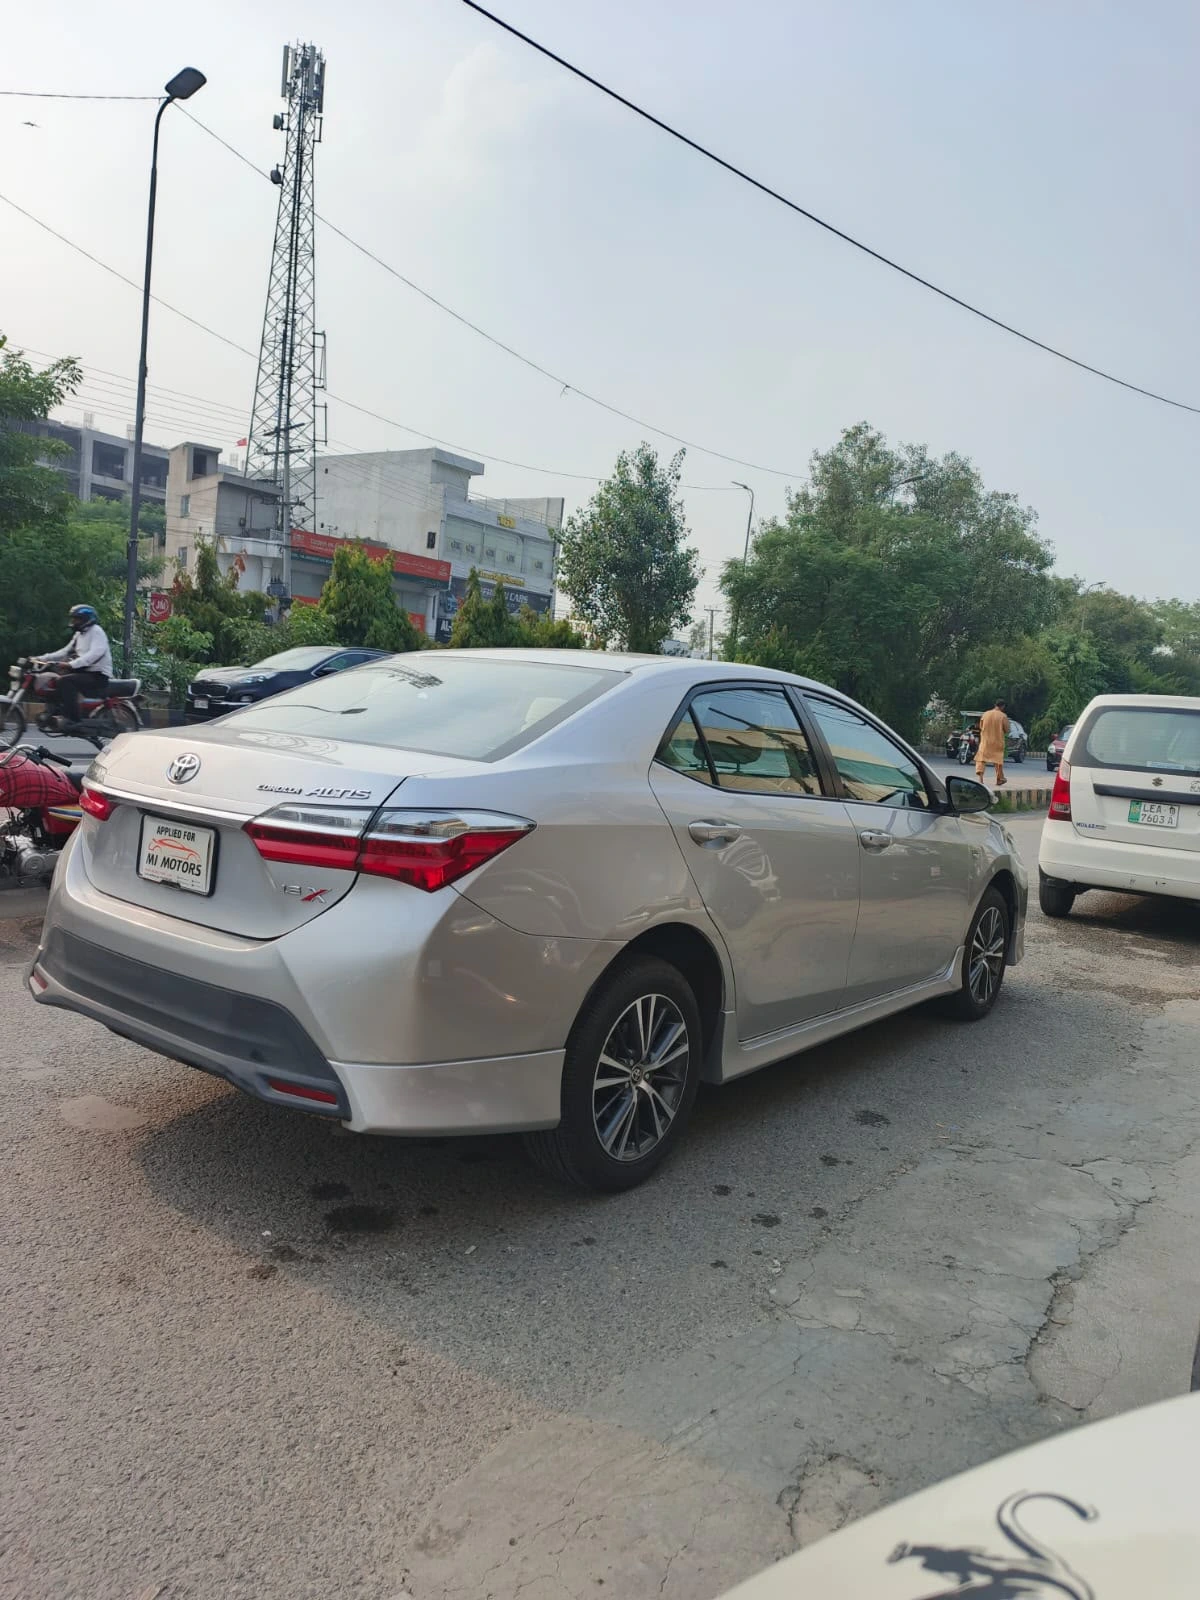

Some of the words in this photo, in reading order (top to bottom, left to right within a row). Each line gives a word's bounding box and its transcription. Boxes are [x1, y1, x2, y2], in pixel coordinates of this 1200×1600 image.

[305, 787, 371, 800] ALTIS
[1144, 803, 1162, 813] LEA
[1142, 813, 1164, 824] 7603
[156, 825, 182, 838] APPLIED
[182, 830, 196, 841] FOR
[146, 853, 158, 865] MI
[160, 856, 202, 876] MOTORS
